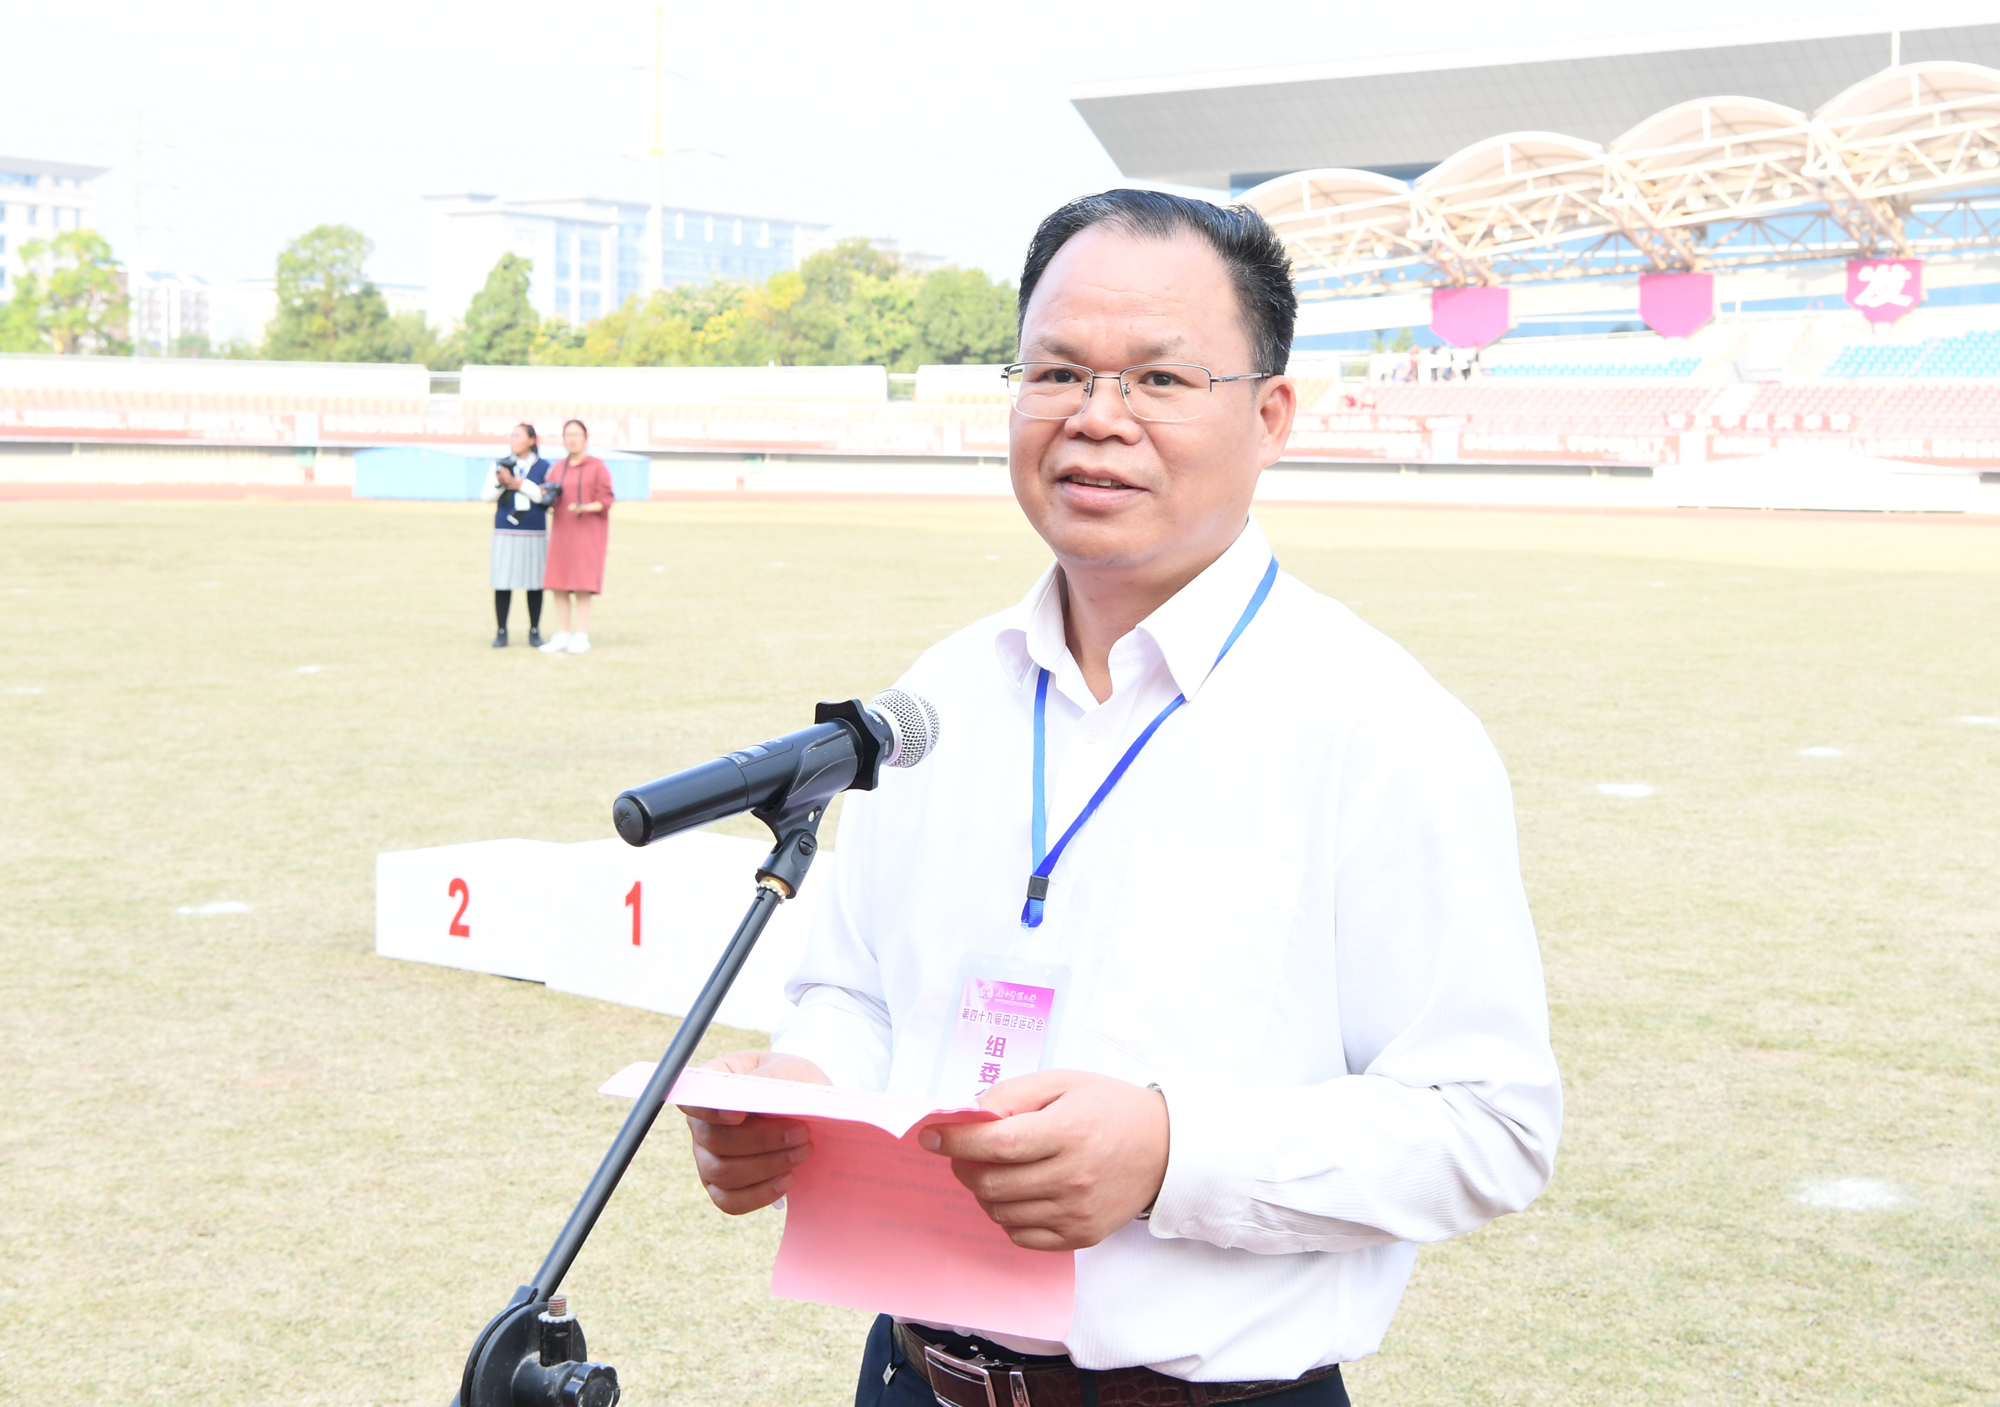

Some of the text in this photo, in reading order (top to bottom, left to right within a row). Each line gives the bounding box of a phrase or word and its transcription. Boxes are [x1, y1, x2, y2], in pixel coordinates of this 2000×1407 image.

[448, 877, 470, 938] 2
[625, 880, 642, 946] 1
[961, 1008, 1044, 1032] 第四十九届田径运动会
[975, 1035, 1007, 1097] 组委
